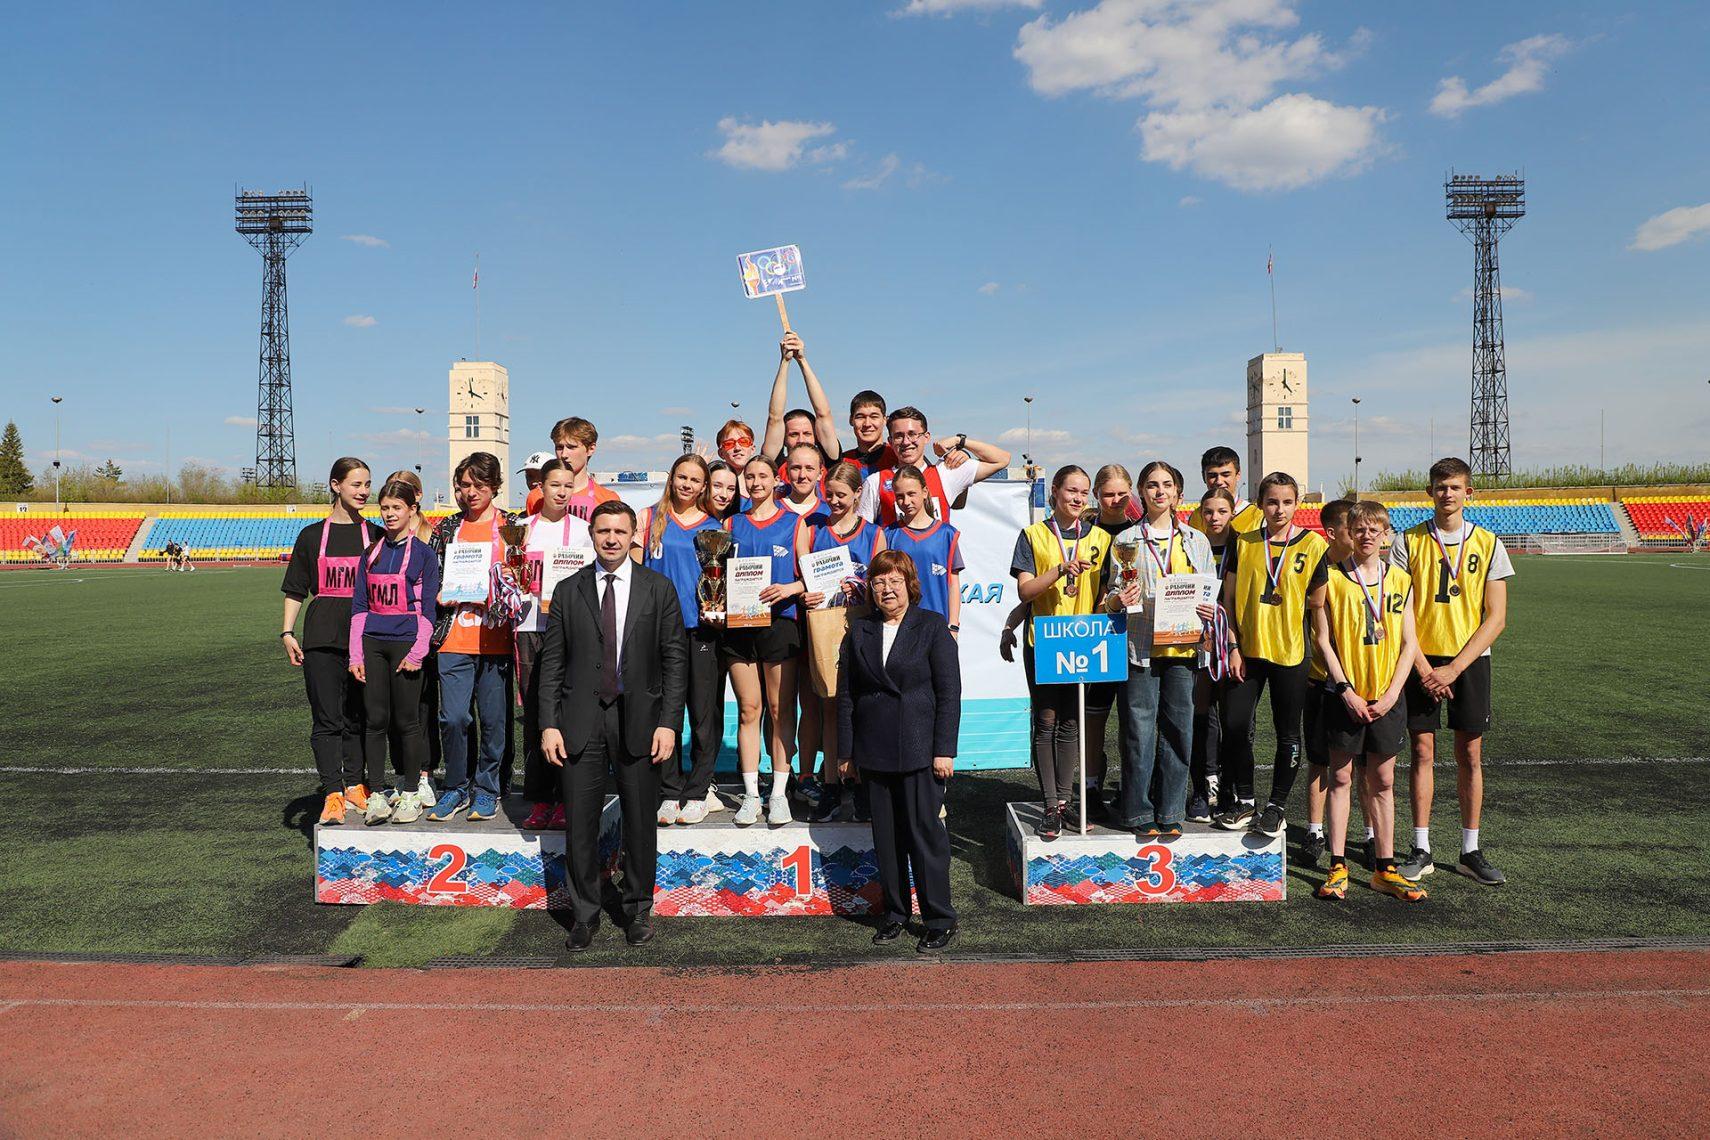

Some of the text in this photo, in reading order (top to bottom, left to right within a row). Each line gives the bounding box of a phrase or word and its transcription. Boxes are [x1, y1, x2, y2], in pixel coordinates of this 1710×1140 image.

[1293, 552, 1308, 574] 5
[1467, 553, 1479, 574] 8
[1386, 592, 1404, 615] 12
[1043, 620, 1118, 639] ШКОЛА
[1289, 744, 1299, 768] FILA
[427, 843, 468, 893] 2
[781, 845, 812, 896] 1
[1134, 844, 1177, 895] 3
